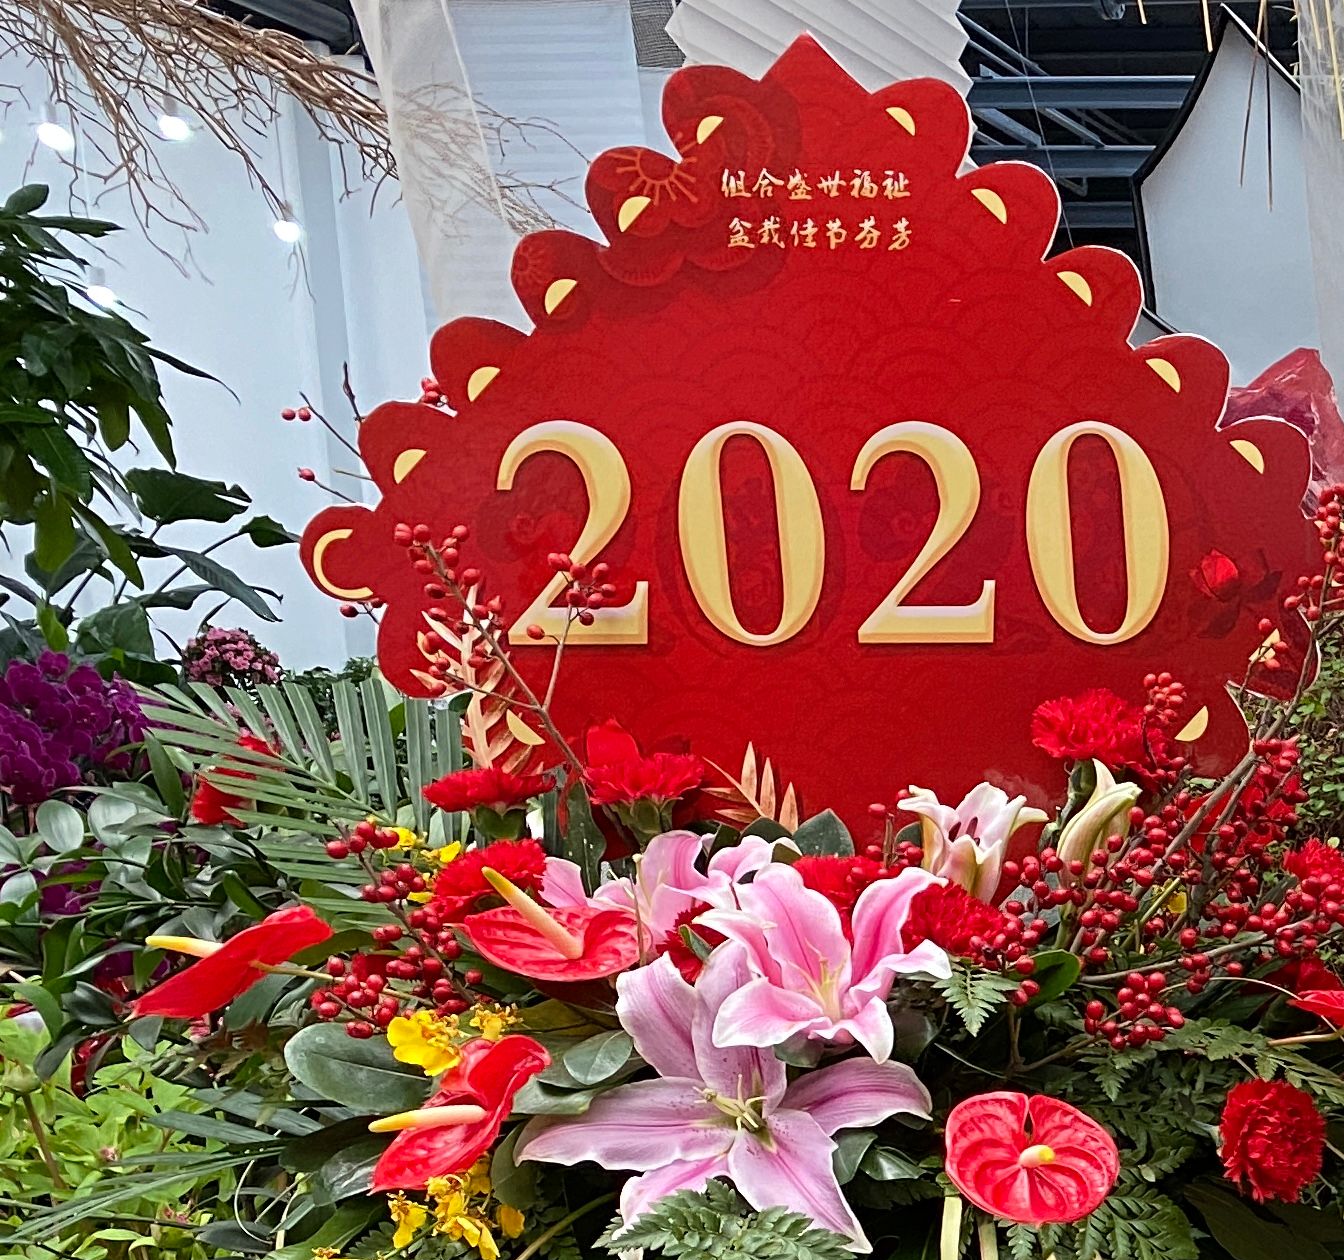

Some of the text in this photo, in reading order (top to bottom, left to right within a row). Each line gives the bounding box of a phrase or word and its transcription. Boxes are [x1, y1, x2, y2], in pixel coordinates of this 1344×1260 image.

[720, 167, 911, 200] 组合盛世福祉
[727, 215, 912, 251] 盆栽佳节芬芳
[496, 420, 1169, 646] 2020
